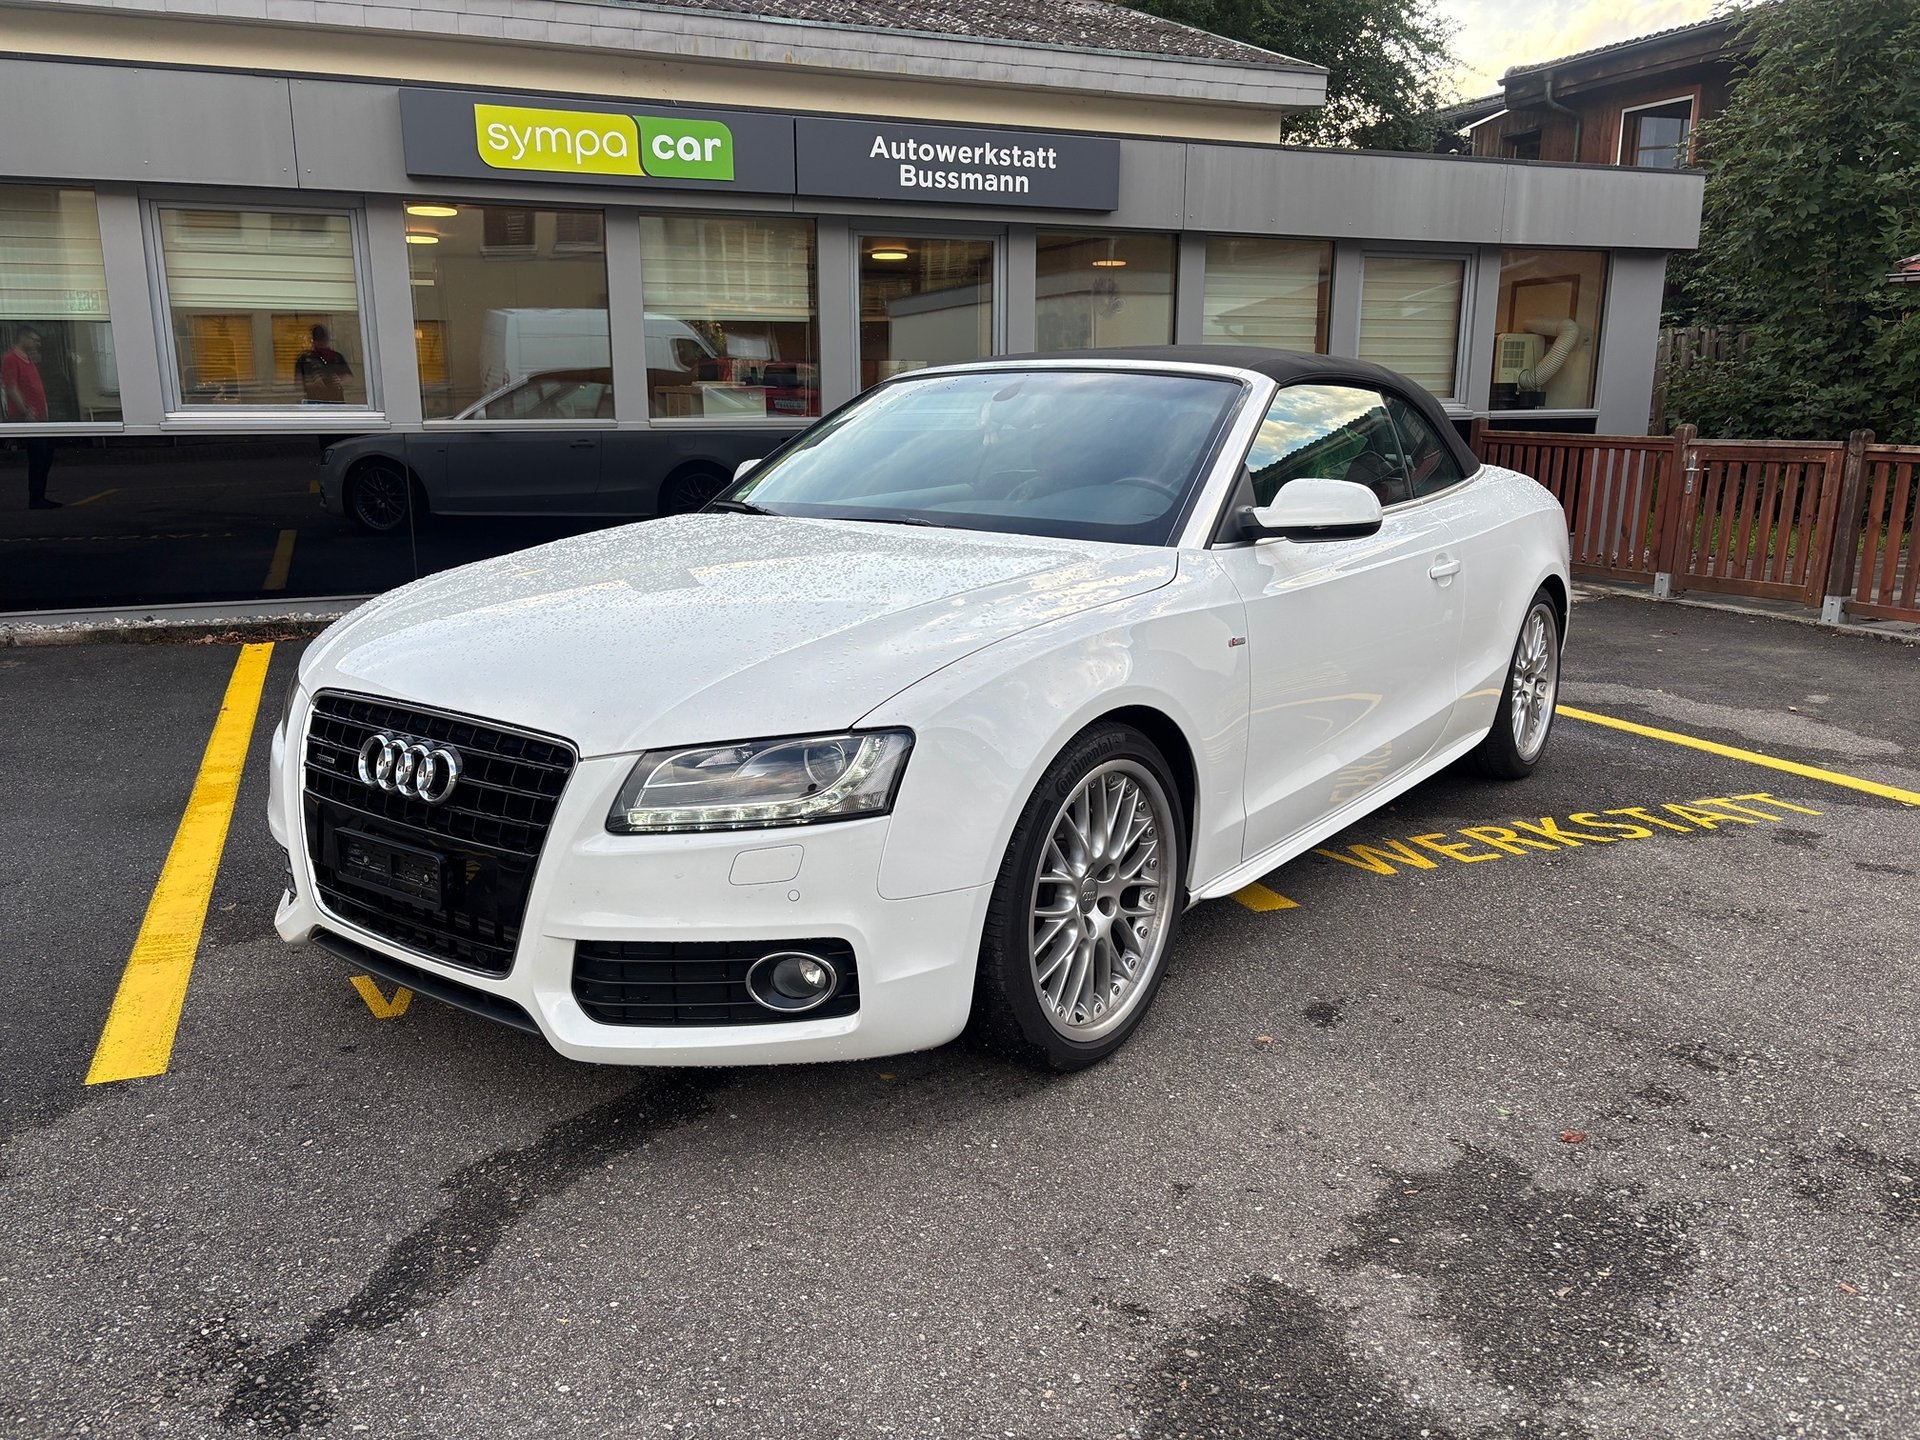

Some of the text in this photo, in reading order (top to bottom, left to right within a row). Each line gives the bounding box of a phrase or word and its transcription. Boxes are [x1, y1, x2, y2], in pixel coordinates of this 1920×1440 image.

[487, 123, 722, 165] sympa car
[869, 135, 1057, 169] Autowerkstatt
[900, 164, 1030, 193] Bussmann
[1315, 792, 1822, 876] WERKSTATT
